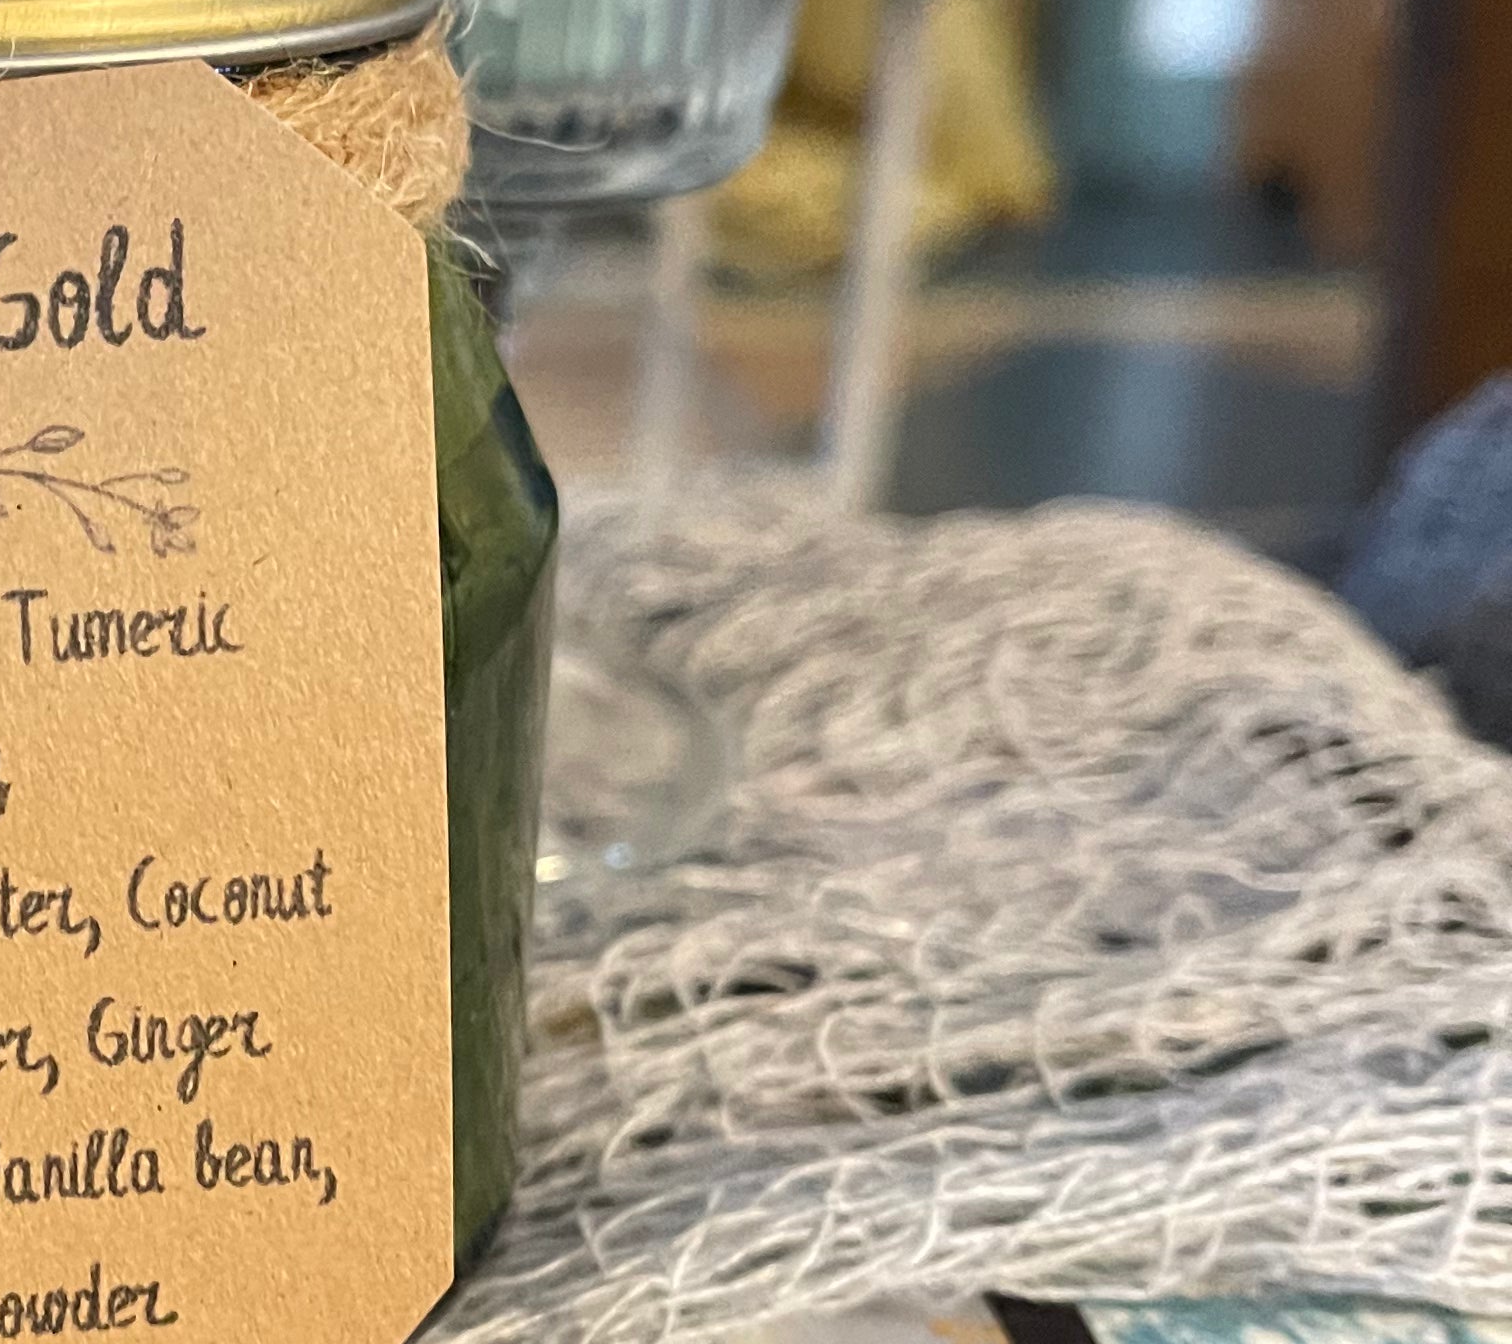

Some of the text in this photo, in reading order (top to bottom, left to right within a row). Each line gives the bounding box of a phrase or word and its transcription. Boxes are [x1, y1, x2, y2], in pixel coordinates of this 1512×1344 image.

[0, 587, 245, 666] Tumeric
[126, 847, 334, 938] Coconut
[86, 995, 273, 1105] Ginger
[193, 1117, 340, 1206] bean,
